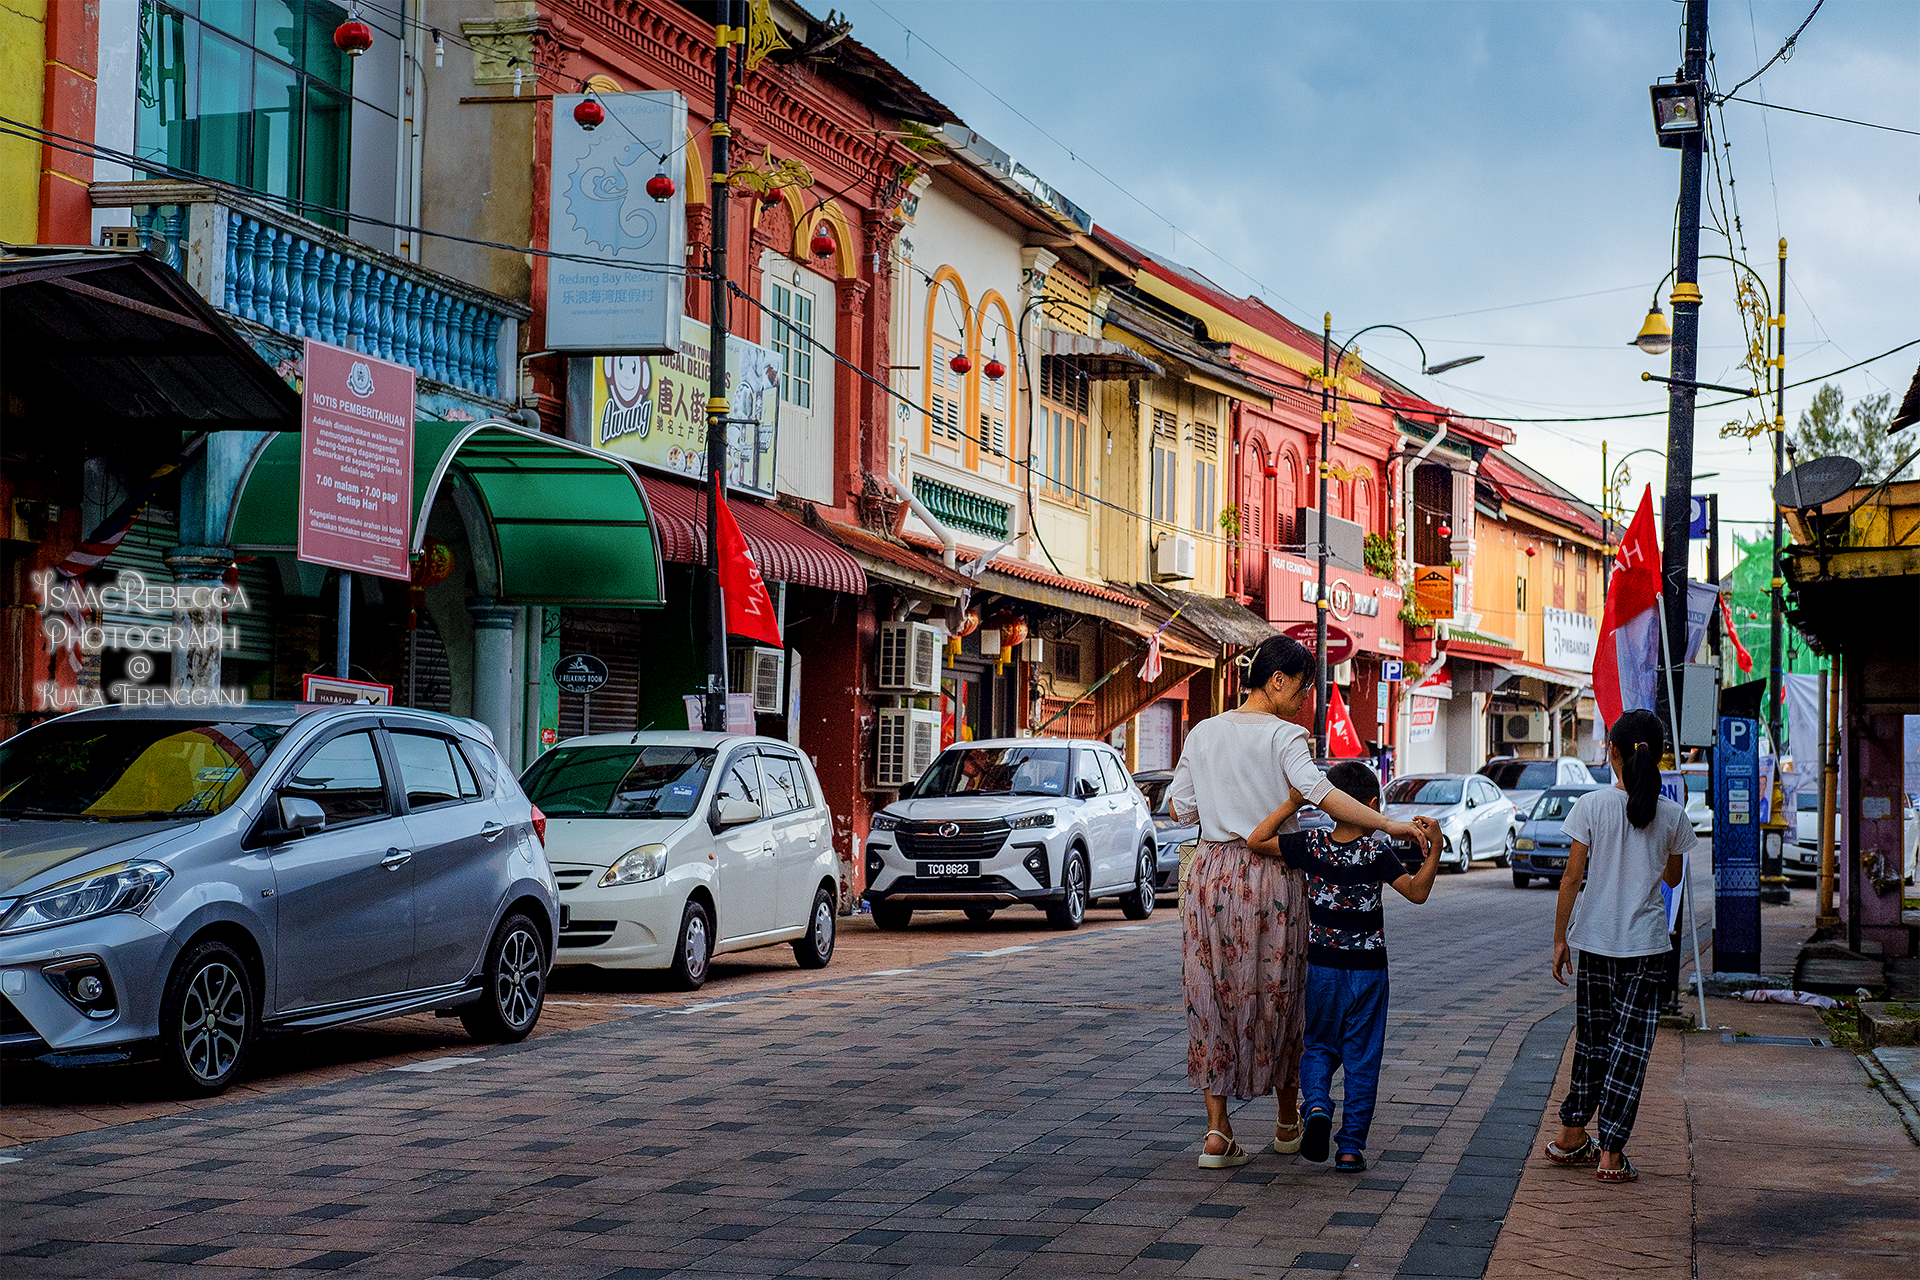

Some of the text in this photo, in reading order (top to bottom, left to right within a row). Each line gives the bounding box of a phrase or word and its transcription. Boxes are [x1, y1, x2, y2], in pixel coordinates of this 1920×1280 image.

[558, 271, 659, 286] Redang Bay Resort
[562, 288, 655, 305] 乐浪海湾度假村
[660, 355, 685, 373] LOCAL
[313, 393, 405, 427] NOTIS PEMBERITAHUAN
[657, 376, 706, 427] 唐人街
[313, 416, 404, 446] Adalah dimaklumkan waktu untuk
[320, 429, 397, 454] memunggah dan mengambil
[313, 447, 403, 476] dibenarkan di sepanjang jalan ini
[316, 437, 400, 467] barang-barang dagangan yang
[340, 464, 375, 479] adalah pada:
[316, 474, 332, 487] 7.00
[334, 480, 359, 494] malam
[365, 486, 380, 499] 7.00
[382, 491, 398, 504] pagi
[337, 492, 377, 511] Setiap Hari
[563, 674, 586, 682] RELAXING
[588, 675, 603, 683] ROOM
[1388, 663, 1400, 680] P
[1730, 721, 1747, 745] P
[927, 864, 969, 875] TCQ 8623
